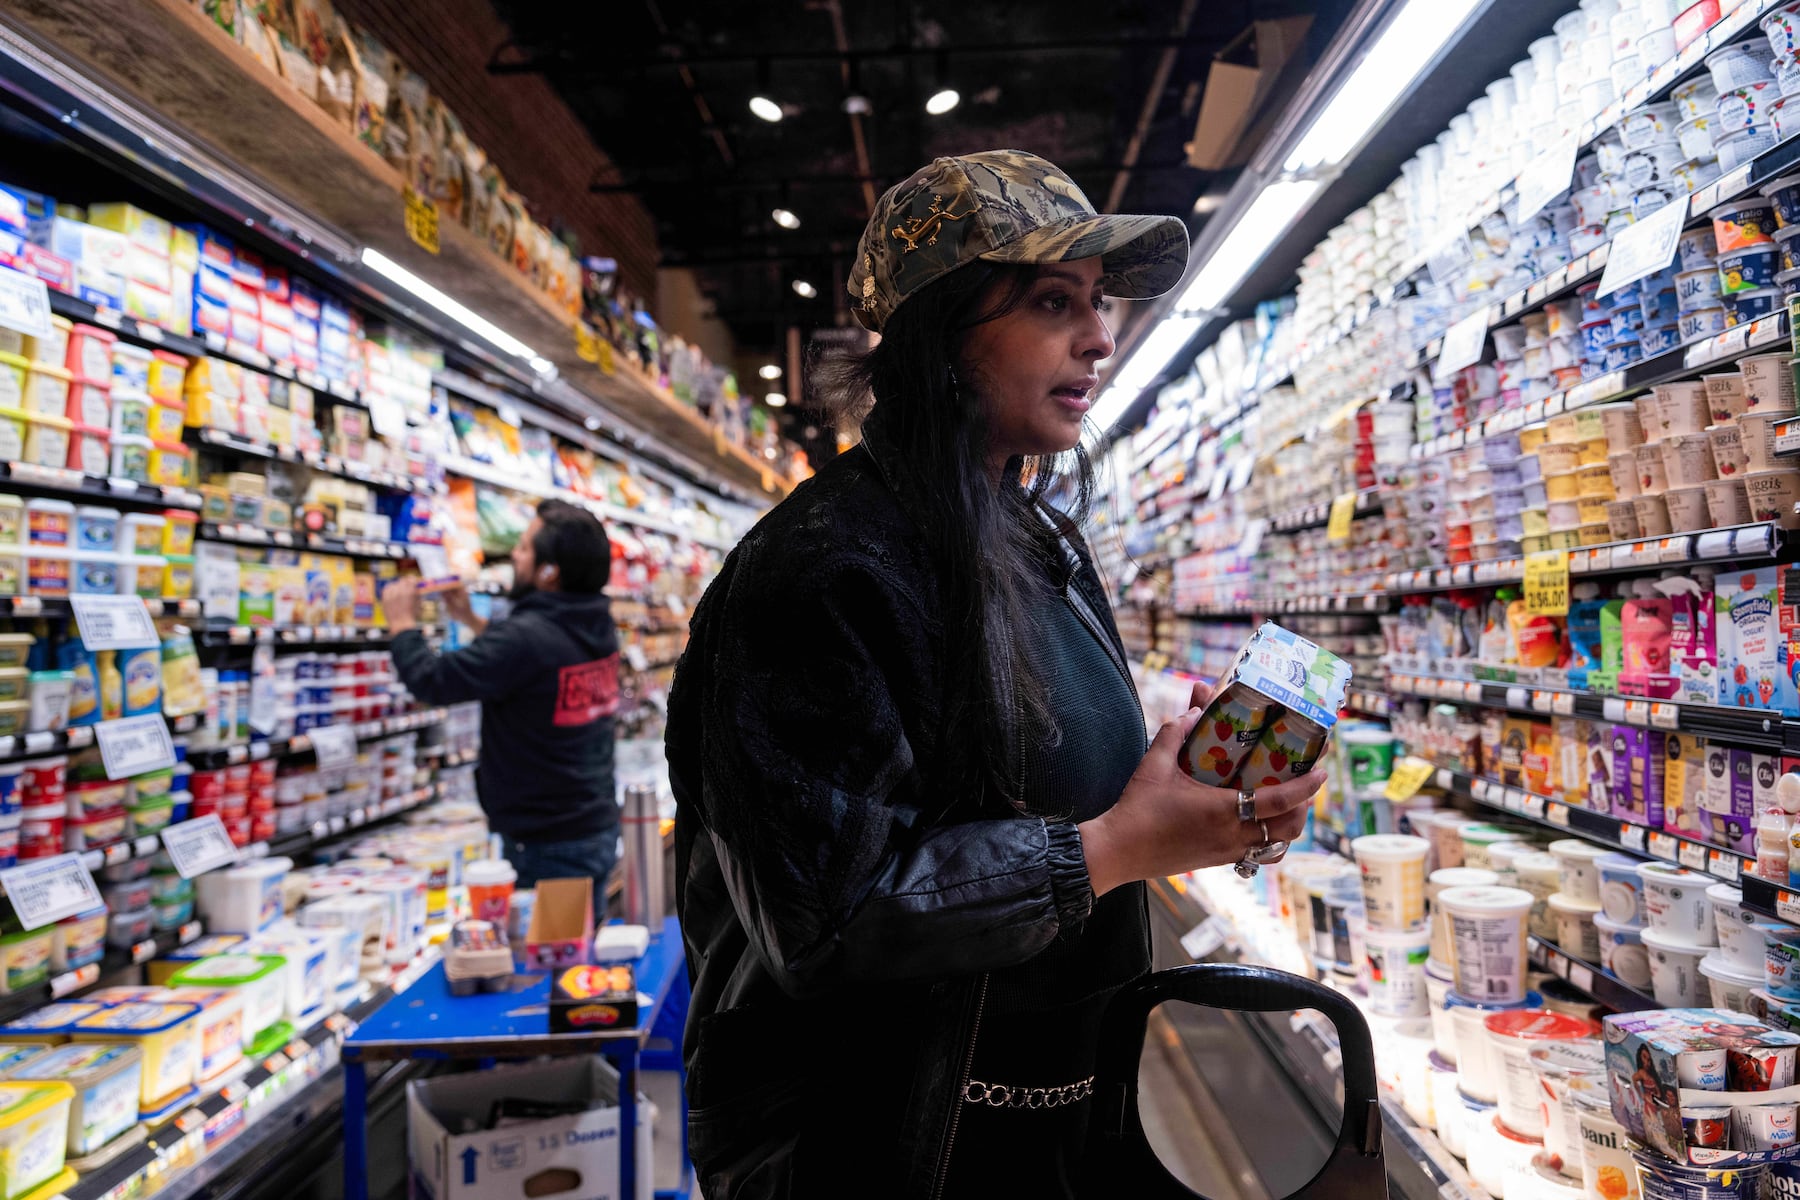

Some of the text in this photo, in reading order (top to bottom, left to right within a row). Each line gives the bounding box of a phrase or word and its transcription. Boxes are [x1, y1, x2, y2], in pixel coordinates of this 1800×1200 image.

[1732, 598, 1771, 621] Stonyfield
[1739, 615, 1767, 628] ORGANIC
[1743, 626, 1765, 636] YOGURT
[566, 1127, 616, 1146] Dozen
